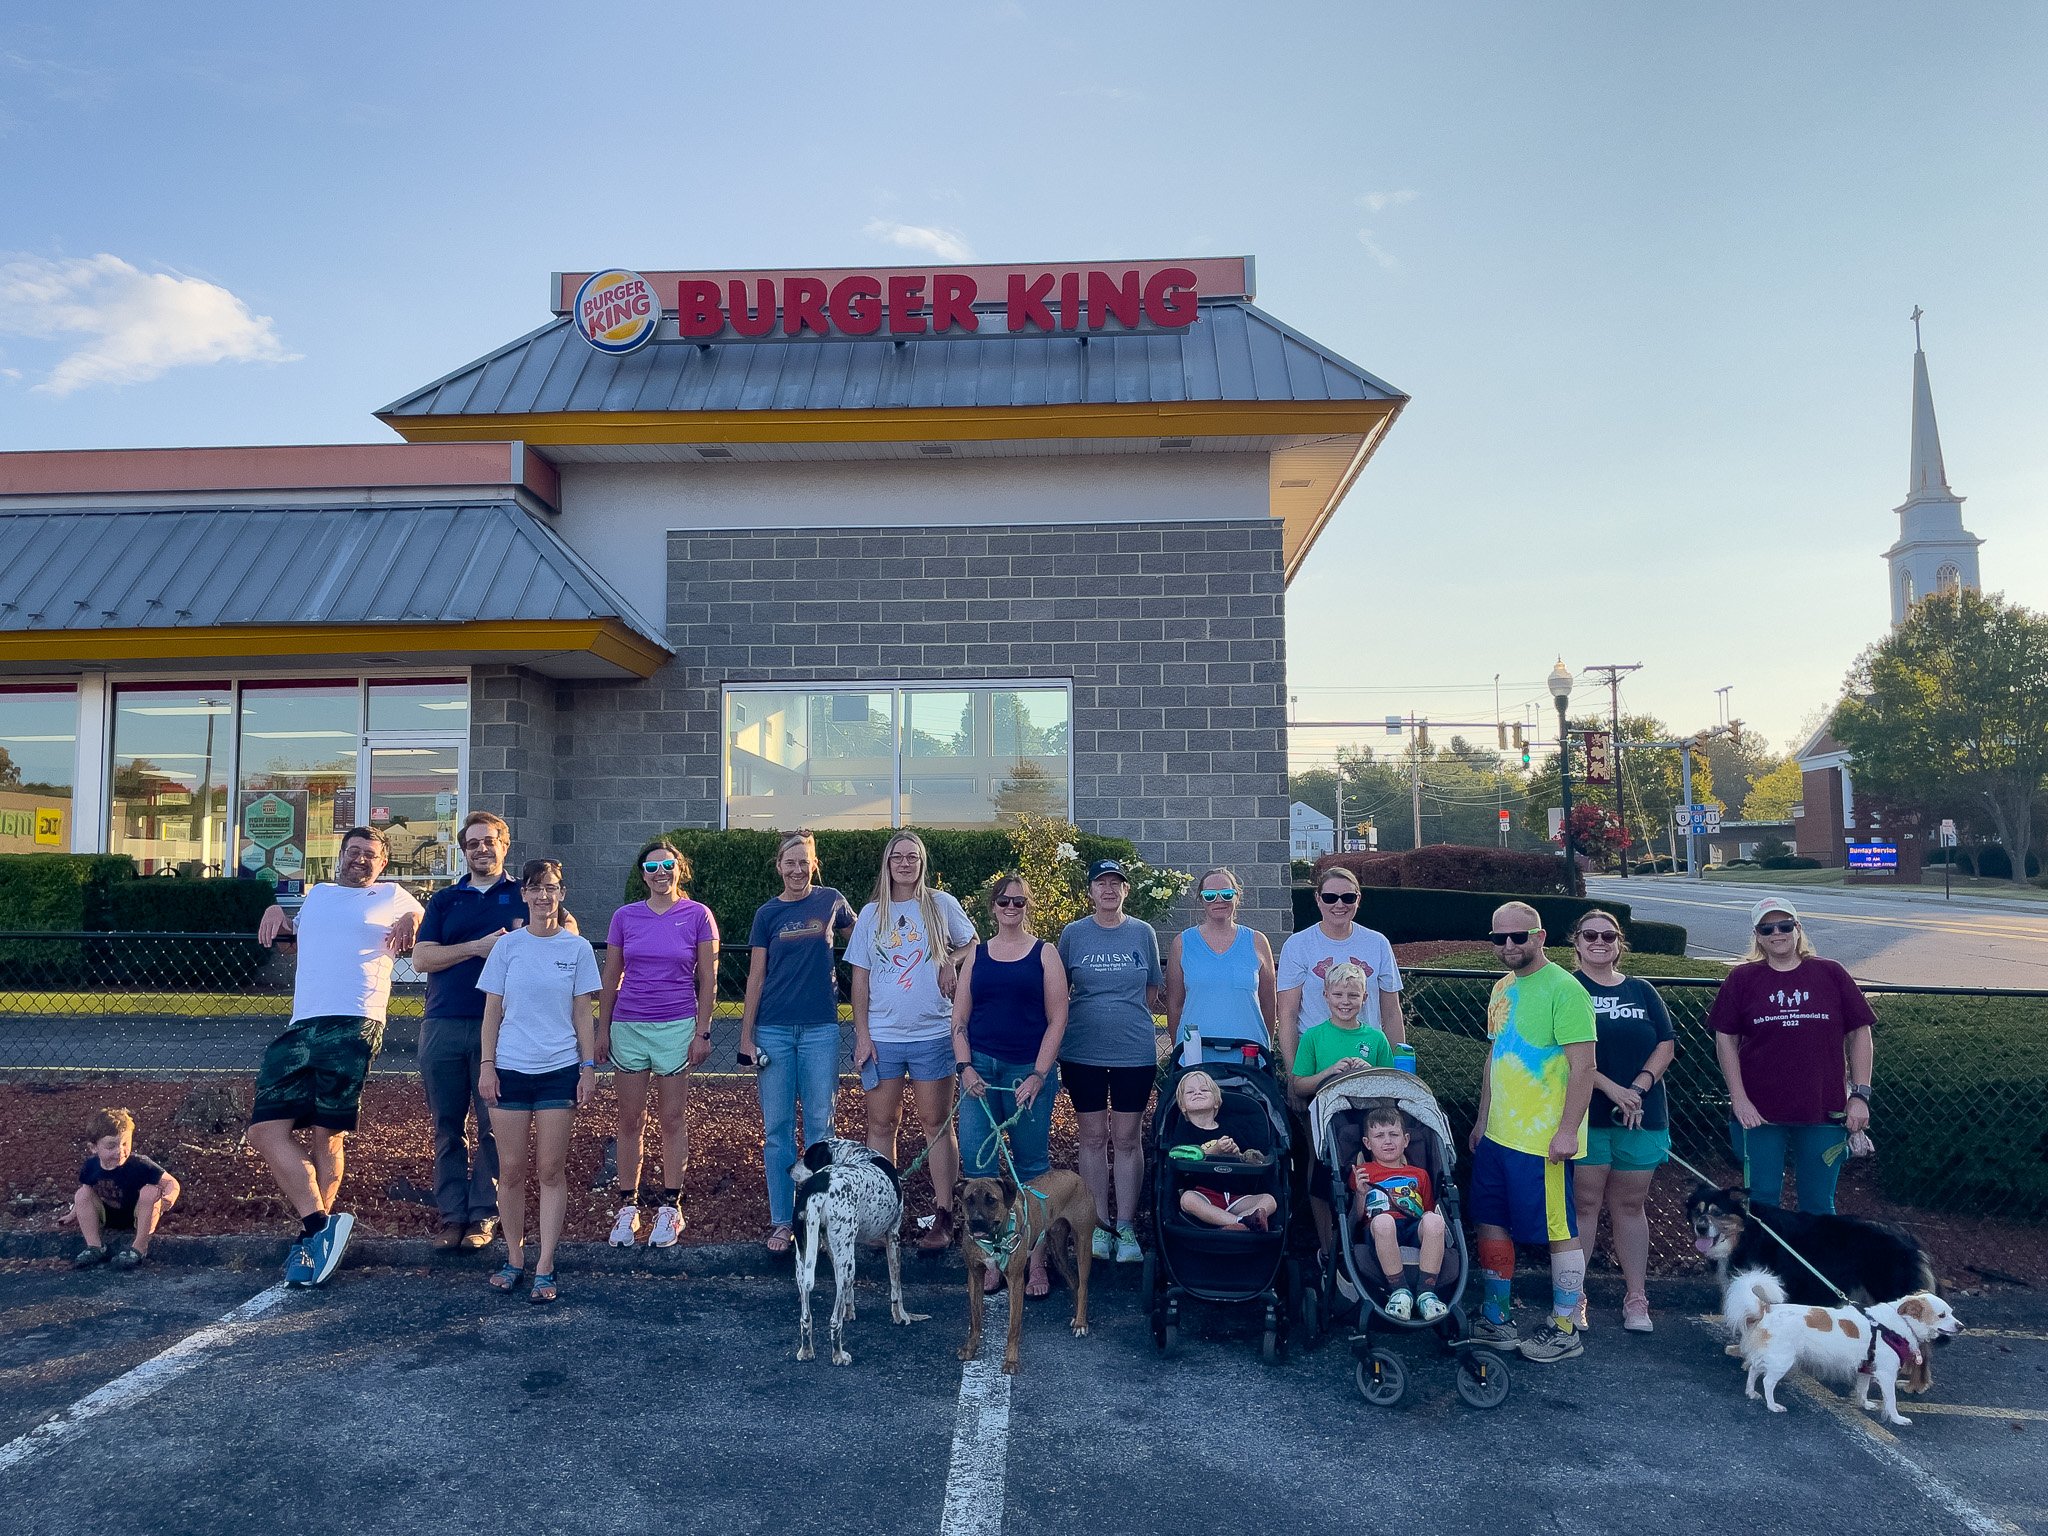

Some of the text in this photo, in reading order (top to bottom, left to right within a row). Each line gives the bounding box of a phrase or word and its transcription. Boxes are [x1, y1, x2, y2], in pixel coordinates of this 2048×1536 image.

[584, 281, 645, 317] BURGER
[678, 268, 1198, 337] BURGER KING
[588, 294, 651, 339] KING
[1694, 815, 1702, 823] 81
[1081, 953, 1132, 963] FINISH
[1764, 1014, 1789, 1022] Duncan
